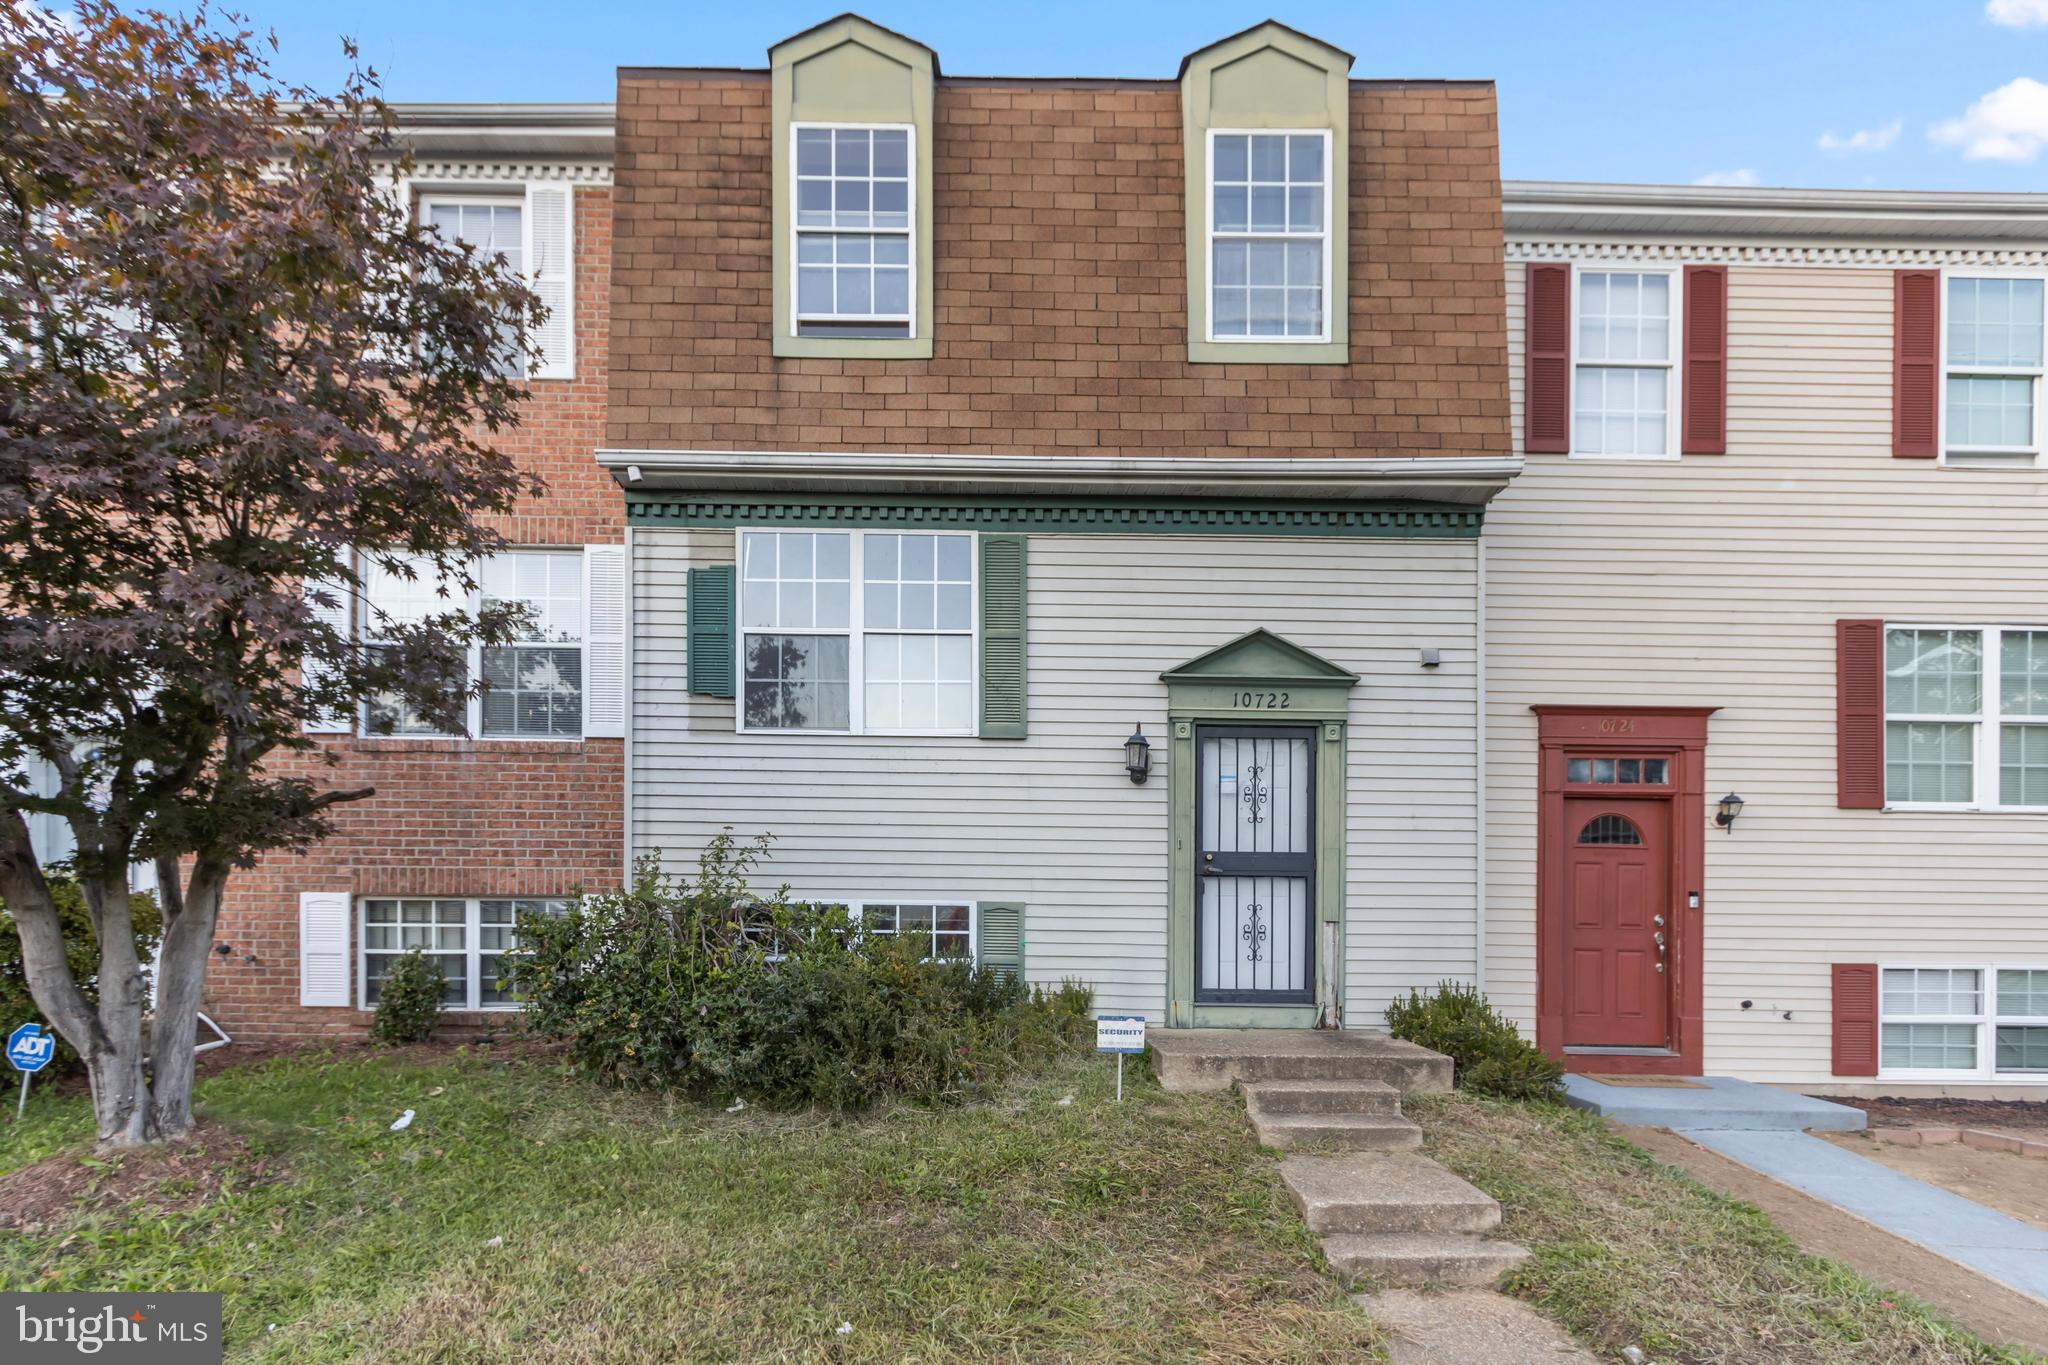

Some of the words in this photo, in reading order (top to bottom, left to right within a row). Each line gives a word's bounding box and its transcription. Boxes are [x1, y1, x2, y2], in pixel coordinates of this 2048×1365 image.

[1233, 692, 1290, 709] 10722
[1098, 1028, 1143, 1036] SECURITY
[12, 1036, 51, 1056] ADT
